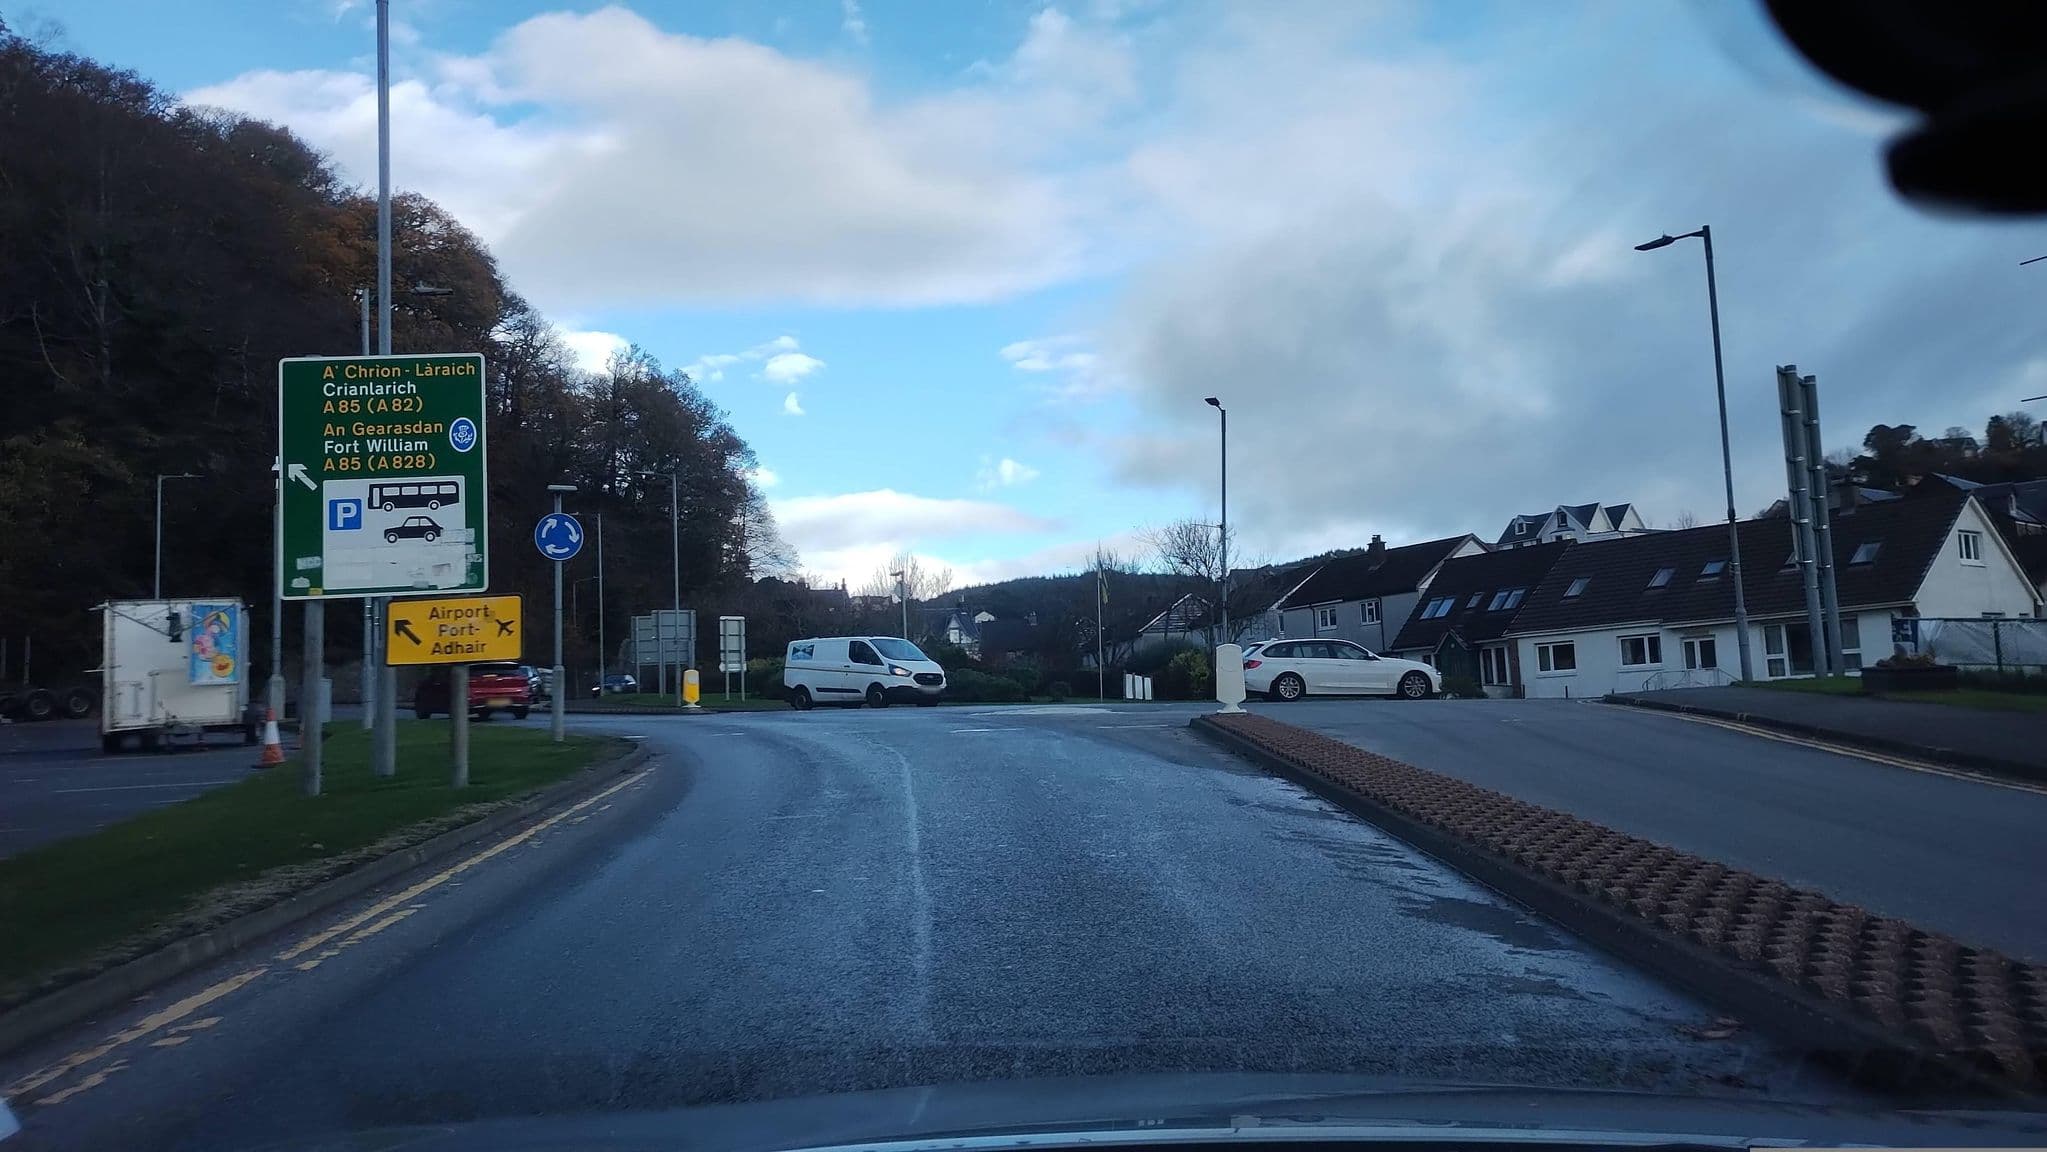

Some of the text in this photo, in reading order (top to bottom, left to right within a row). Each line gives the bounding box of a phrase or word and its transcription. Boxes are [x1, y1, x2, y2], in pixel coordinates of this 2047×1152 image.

[415, 362, 476, 377] Làraich
[323, 381, 417, 397] Crianlarich
[323, 396, 424, 414] A85 (A82)
[323, 420, 443, 437] An Gearasdan
[324, 438, 428, 454] Fort William
[323, 453, 436, 471] A85 (A828)
[337, 502, 357, 528] P
[428, 604, 490, 621] Airport
[430, 640, 487, 655] Adhair
